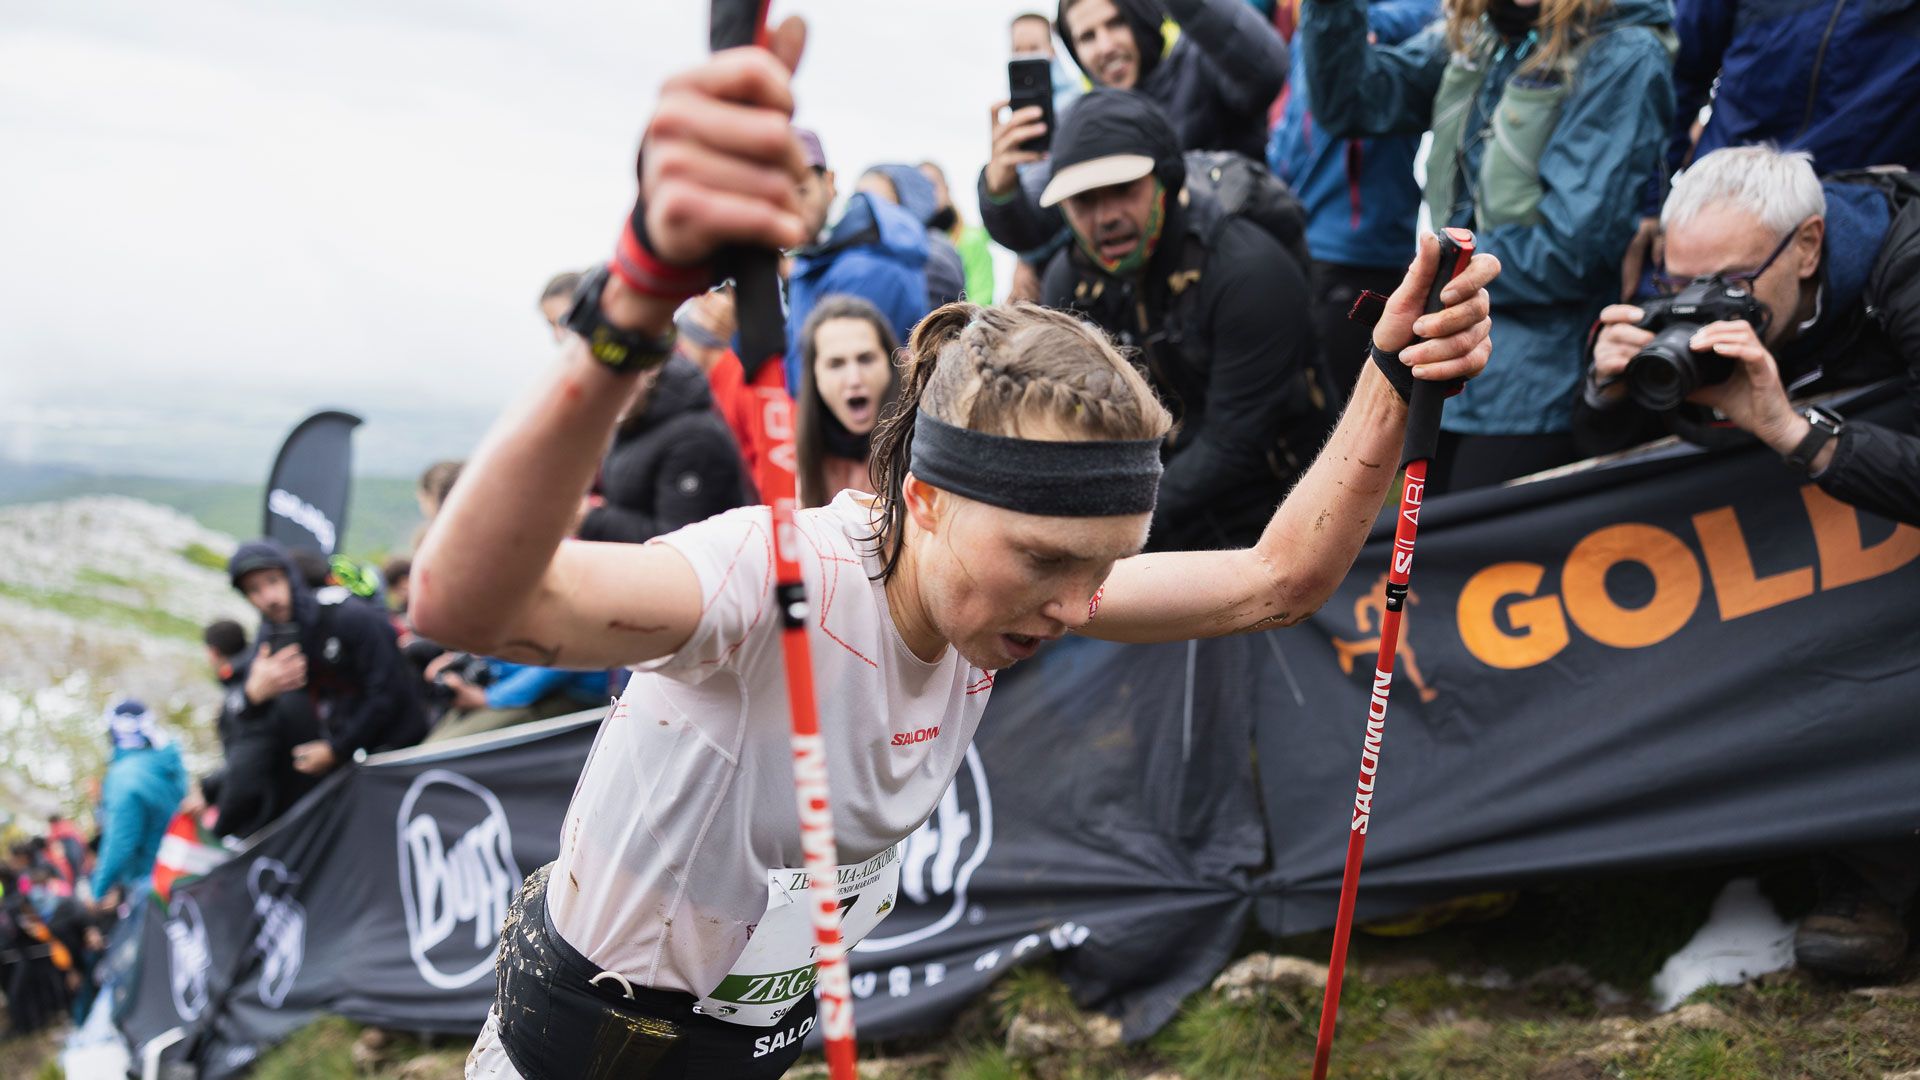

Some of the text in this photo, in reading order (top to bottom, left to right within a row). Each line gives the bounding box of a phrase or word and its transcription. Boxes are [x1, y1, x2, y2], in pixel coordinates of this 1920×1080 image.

[1456, 484, 1920, 670] GOLD
[1352, 668, 1392, 835] SALOMON
[792, 733, 858, 1040] SALOMON
